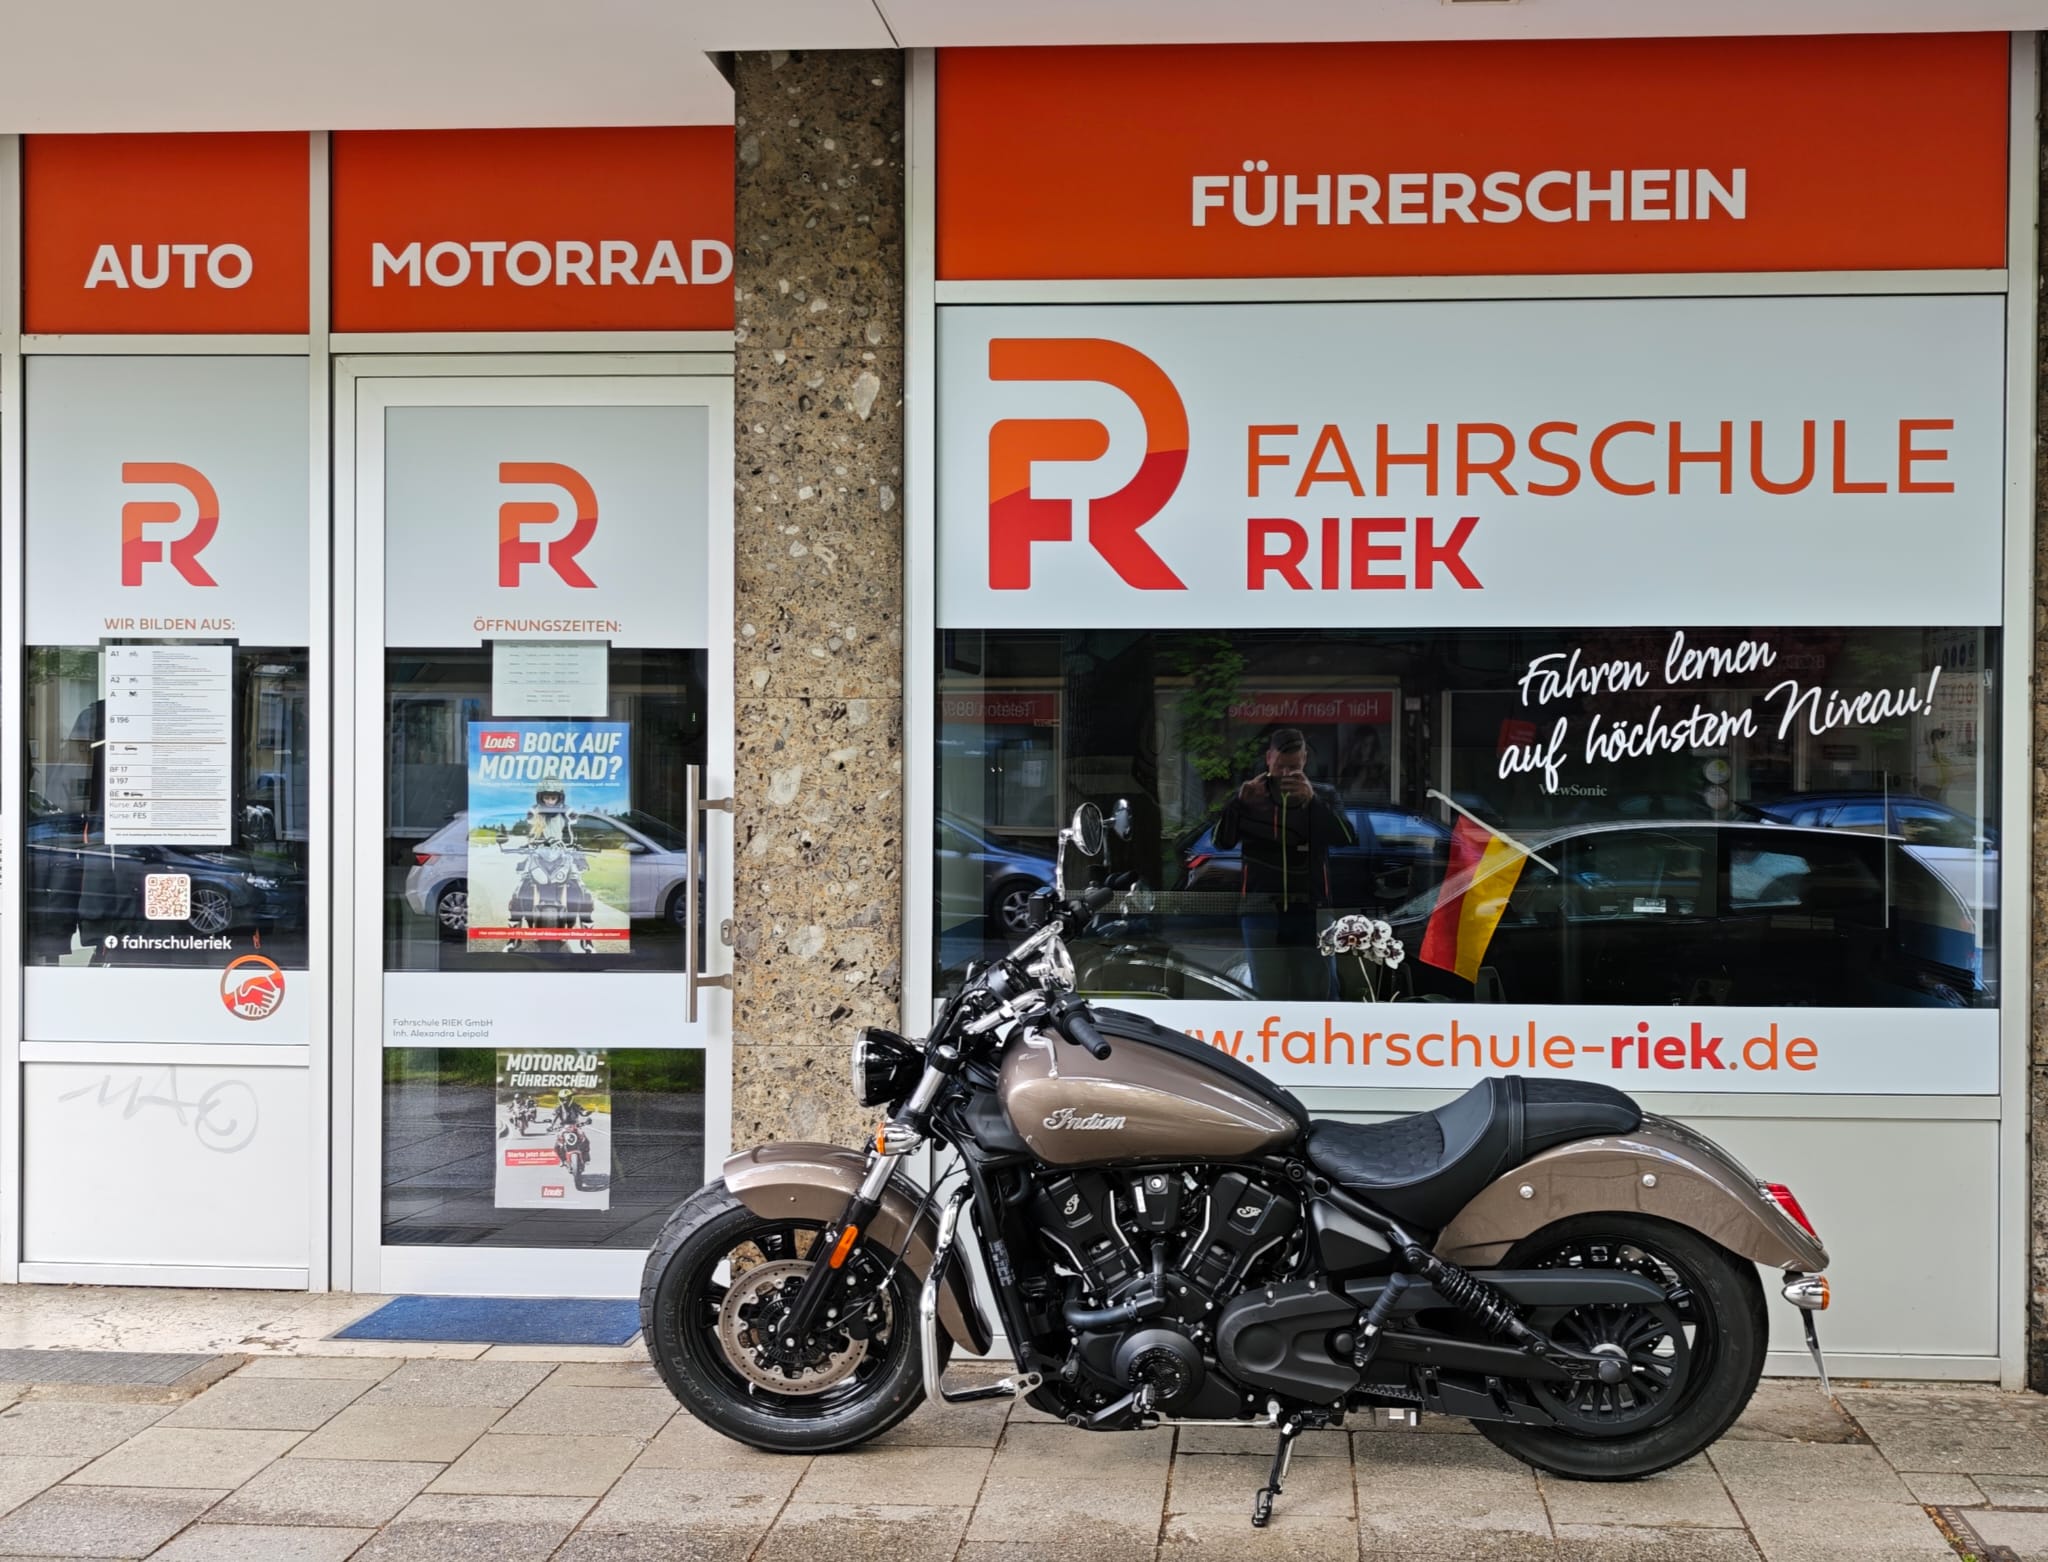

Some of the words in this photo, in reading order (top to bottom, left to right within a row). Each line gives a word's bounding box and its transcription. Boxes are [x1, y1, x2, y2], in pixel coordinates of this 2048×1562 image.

[1193, 160, 1747, 228] FÜHRERSCHEIN
[84, 243, 254, 289] AUTO
[373, 239, 734, 288] MOTORRAD
[1247, 418, 1955, 498] FAHRSCHULE
[1246, 516, 1484, 591] RIEK
[104, 618, 135, 631] WIR
[139, 618, 197, 631] BILDEN
[200, 618, 236, 631] AUS:
[473, 616, 622, 633] ÖFFNUNGSZEITEN:
[1518, 648, 1649, 706] Fahren
[1665, 630, 1776, 685] lernen
[1499, 717, 1567, 793] auf
[1586, 705, 1758, 764] höchstem
[1764, 665, 1942, 740] Niveau!
[483, 735, 517, 749] Louis
[523, 732, 579, 754] BOCK
[579, 732, 622, 754] AUF
[478, 755, 623, 781] MOTORRAD?
[121, 934, 233, 950] fahrschuleriek
[392, 1018, 440, 1027] Fahrschule
[441, 1018, 463, 1027] RIEK
[465, 1018, 494, 1027] GmbH
[392, 1029, 409, 1037] Inh.
[410, 1029, 455, 1037] Alexandra
[457, 1029, 489, 1039] Leipold
[506, 1054, 605, 1072] MOTORRAD-
[510, 1072, 598, 1088] FÜHRERSCHEIN
[1042, 1107, 1127, 1130] Indian
